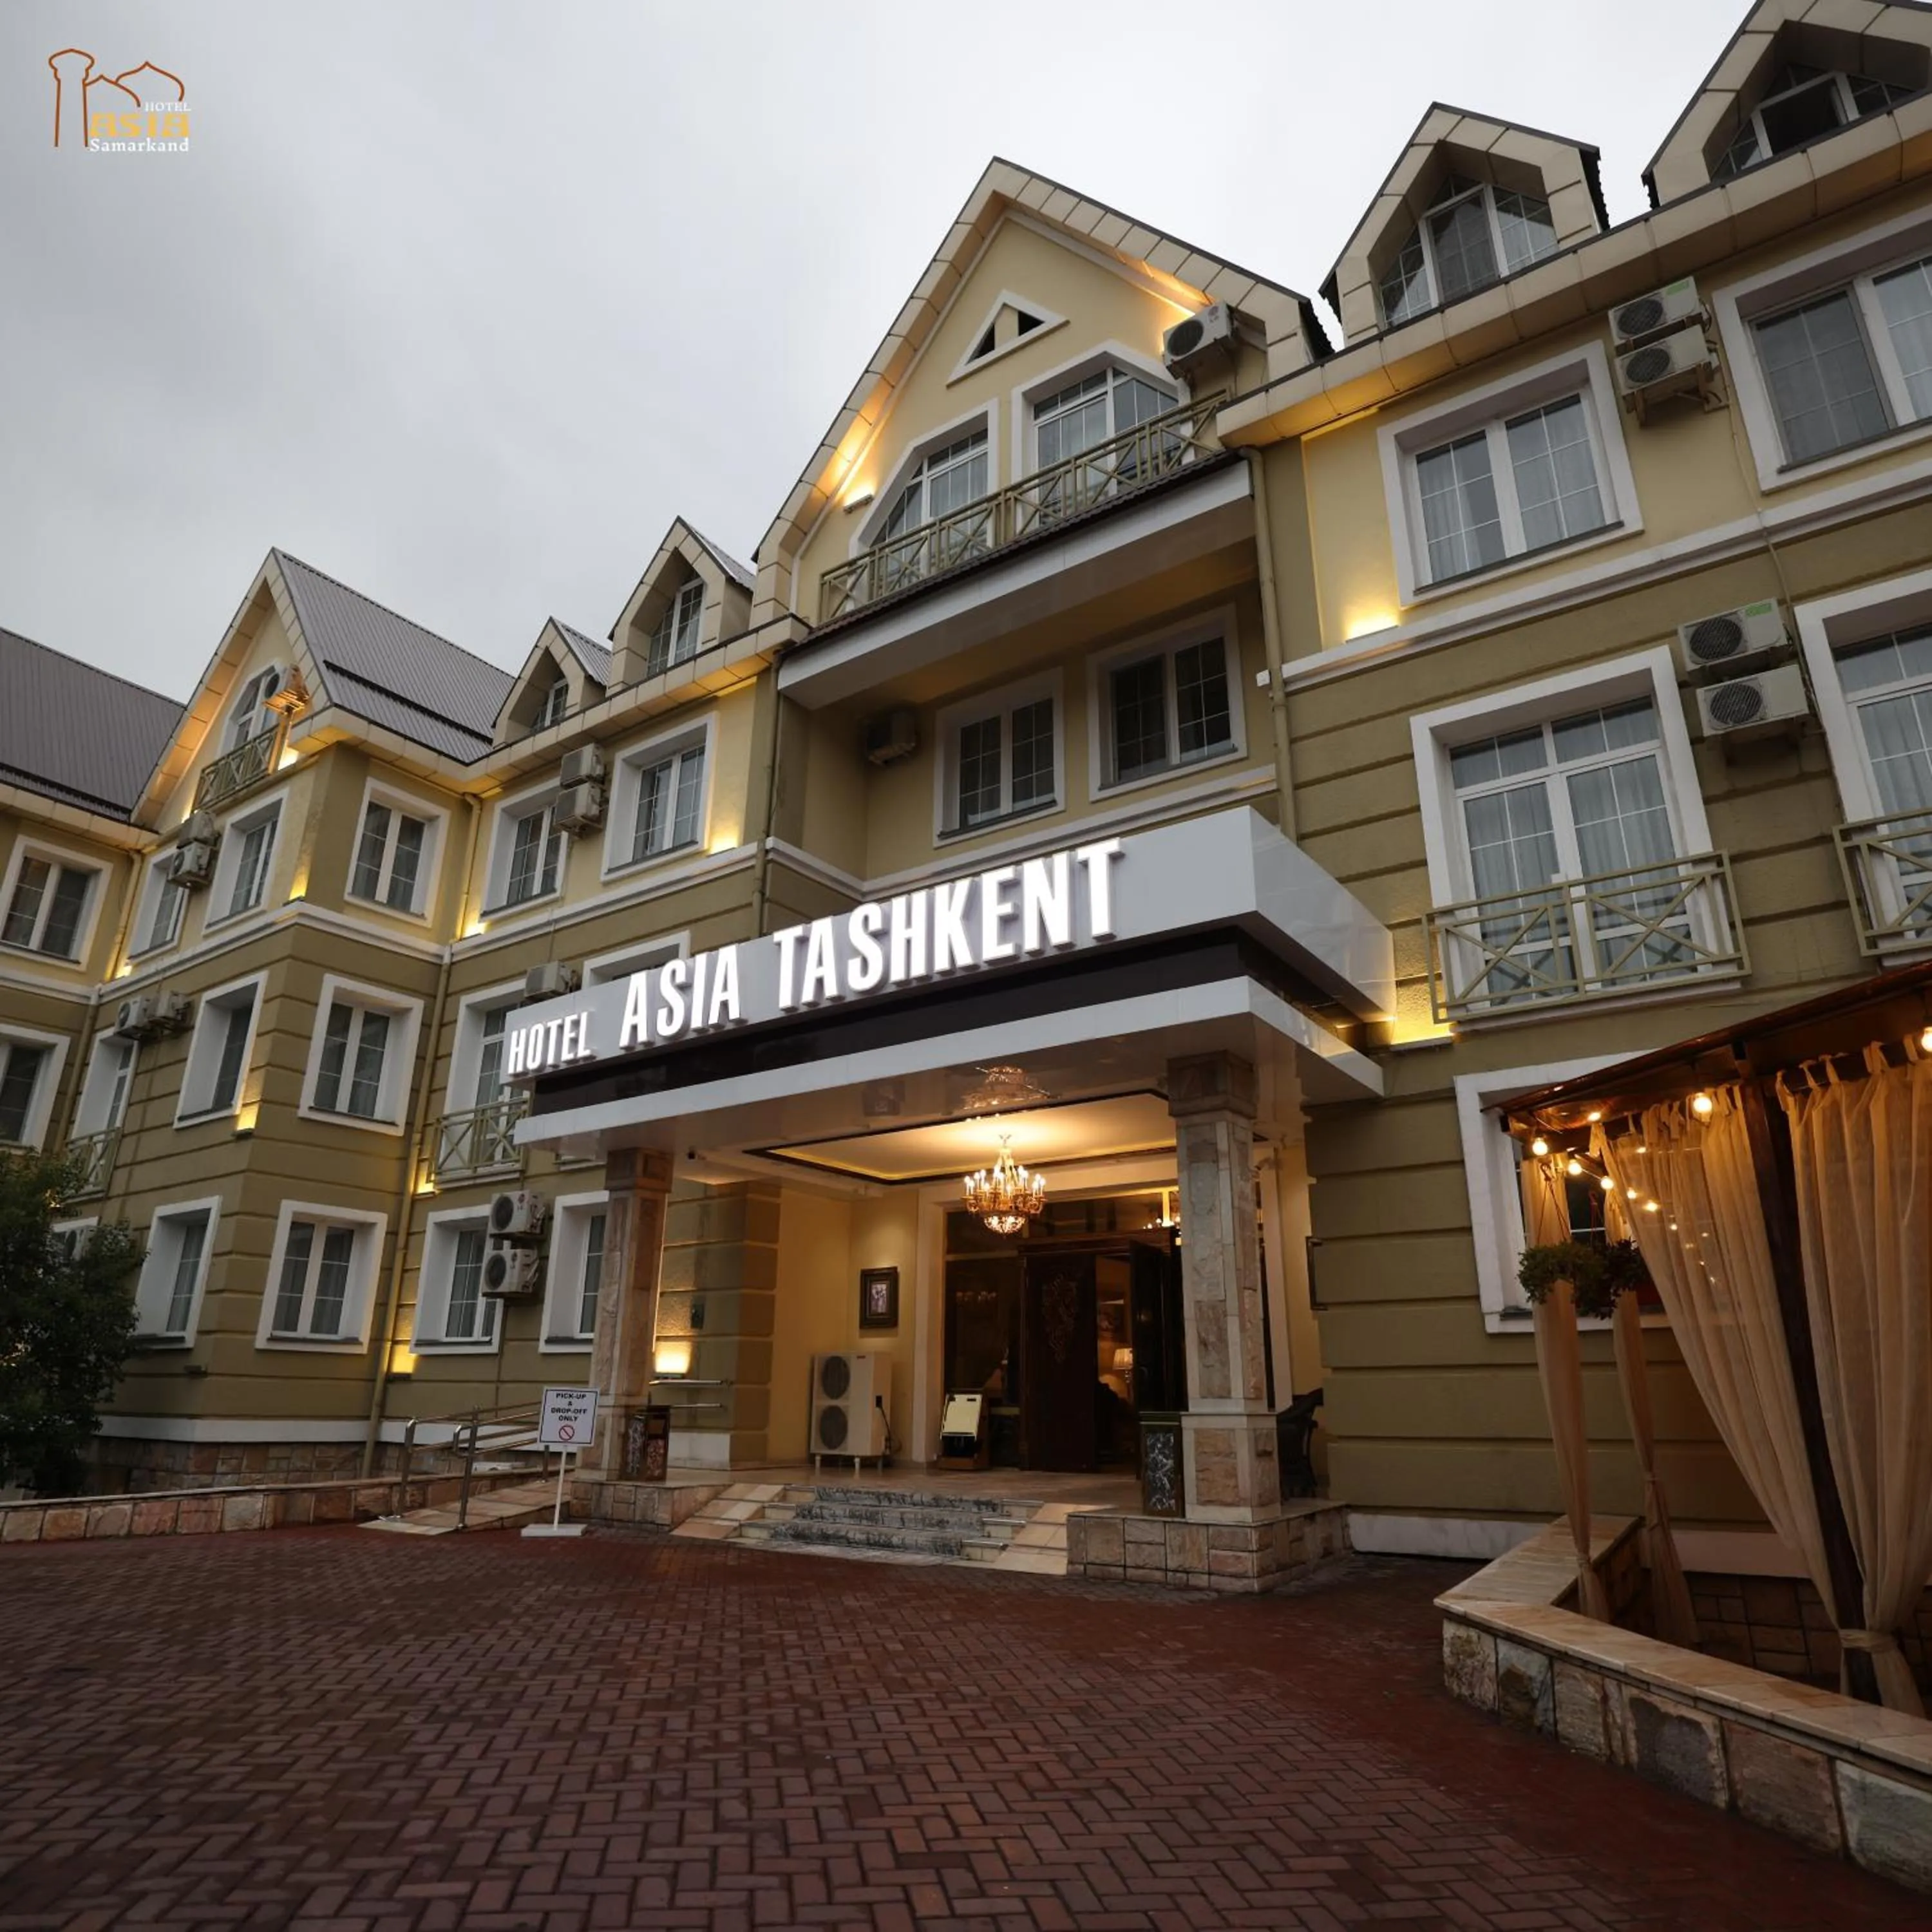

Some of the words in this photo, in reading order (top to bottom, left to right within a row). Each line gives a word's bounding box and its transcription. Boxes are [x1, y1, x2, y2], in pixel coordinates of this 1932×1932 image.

[507, 1010, 593, 1076] HOTEL
[619, 943, 742, 1049] ASIA
[773, 837, 1122, 1010] TASHKENT
